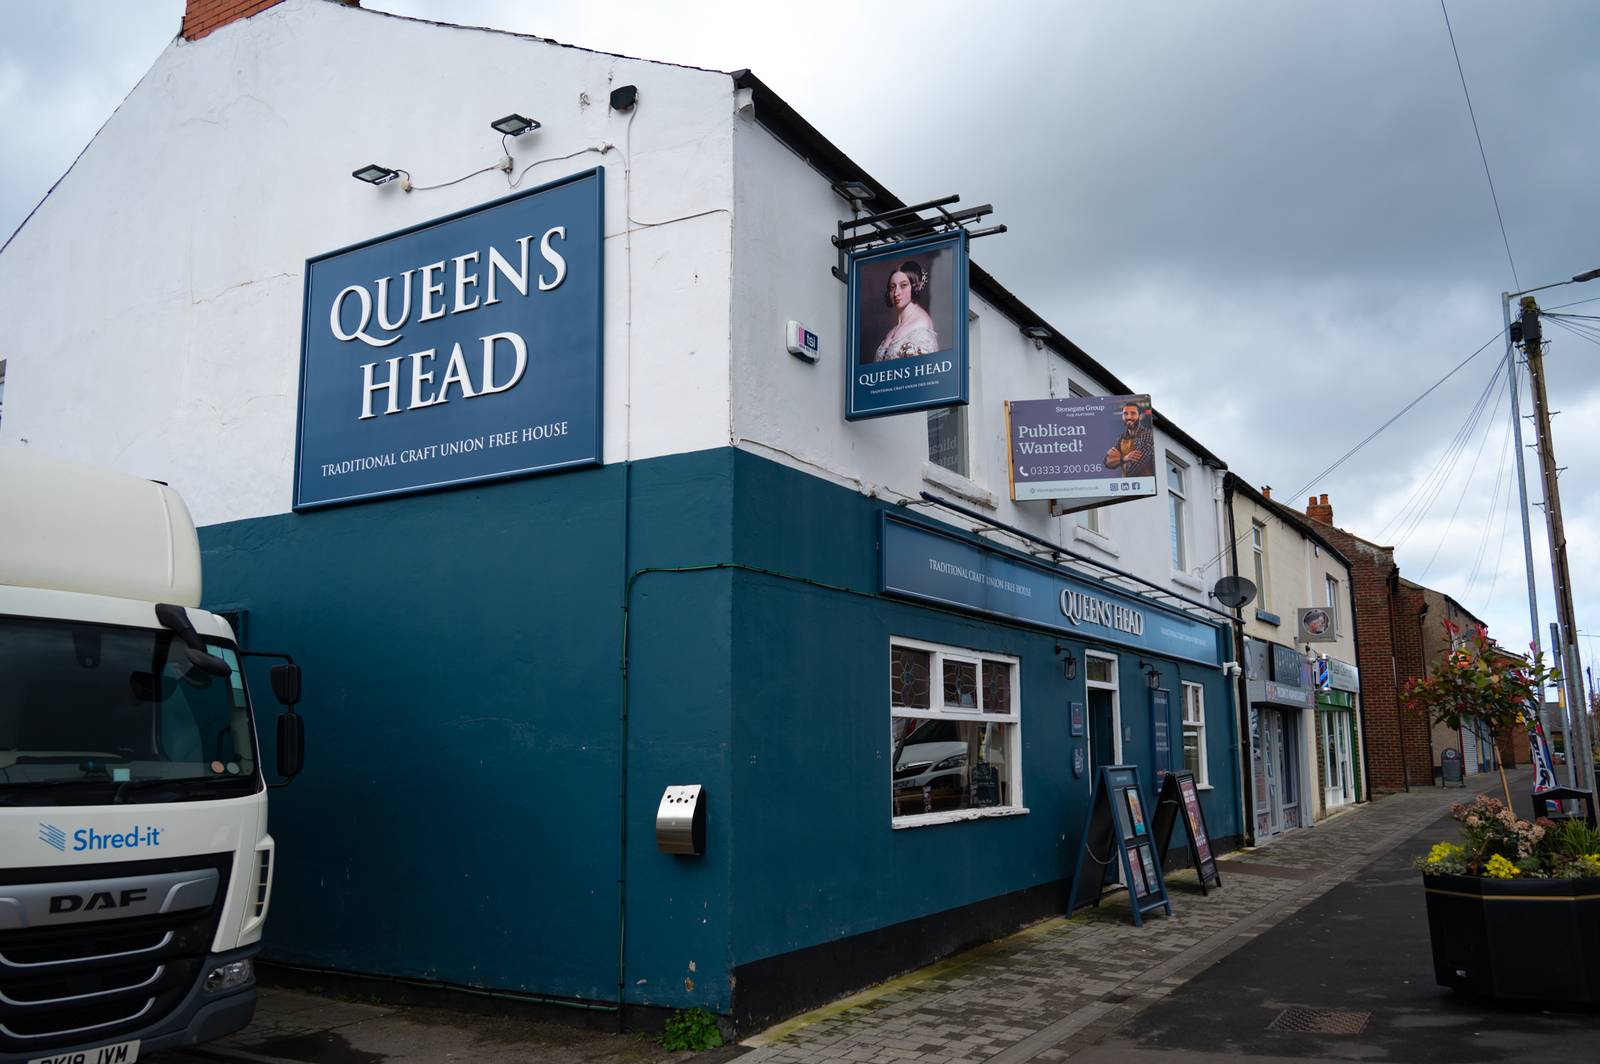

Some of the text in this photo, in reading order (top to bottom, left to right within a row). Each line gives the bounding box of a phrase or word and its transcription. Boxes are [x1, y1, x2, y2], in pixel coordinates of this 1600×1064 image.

[330, 225, 568, 348] QUEENS
[357, 331, 529, 420] HEAD
[858, 360, 953, 387] QUEENS HEAD
[1085, 404, 1105, 412] Group
[1018, 424, 1086, 439] Publican
[320, 421, 569, 478] TRADITIONAL CRAFT UNION FREE HOUSE
[1018, 439, 1083, 455] Wanted!
[1030, 463, 1103, 475] 03333 200 036
[929, 558, 1032, 598] TRADITIONAL CRAFT UNION FREE HOUSE
[1060, 588, 1144, 636] QUEENS HEAD
[73, 825, 160, 851] Shred-it
[48, 887, 148, 914] DAF
